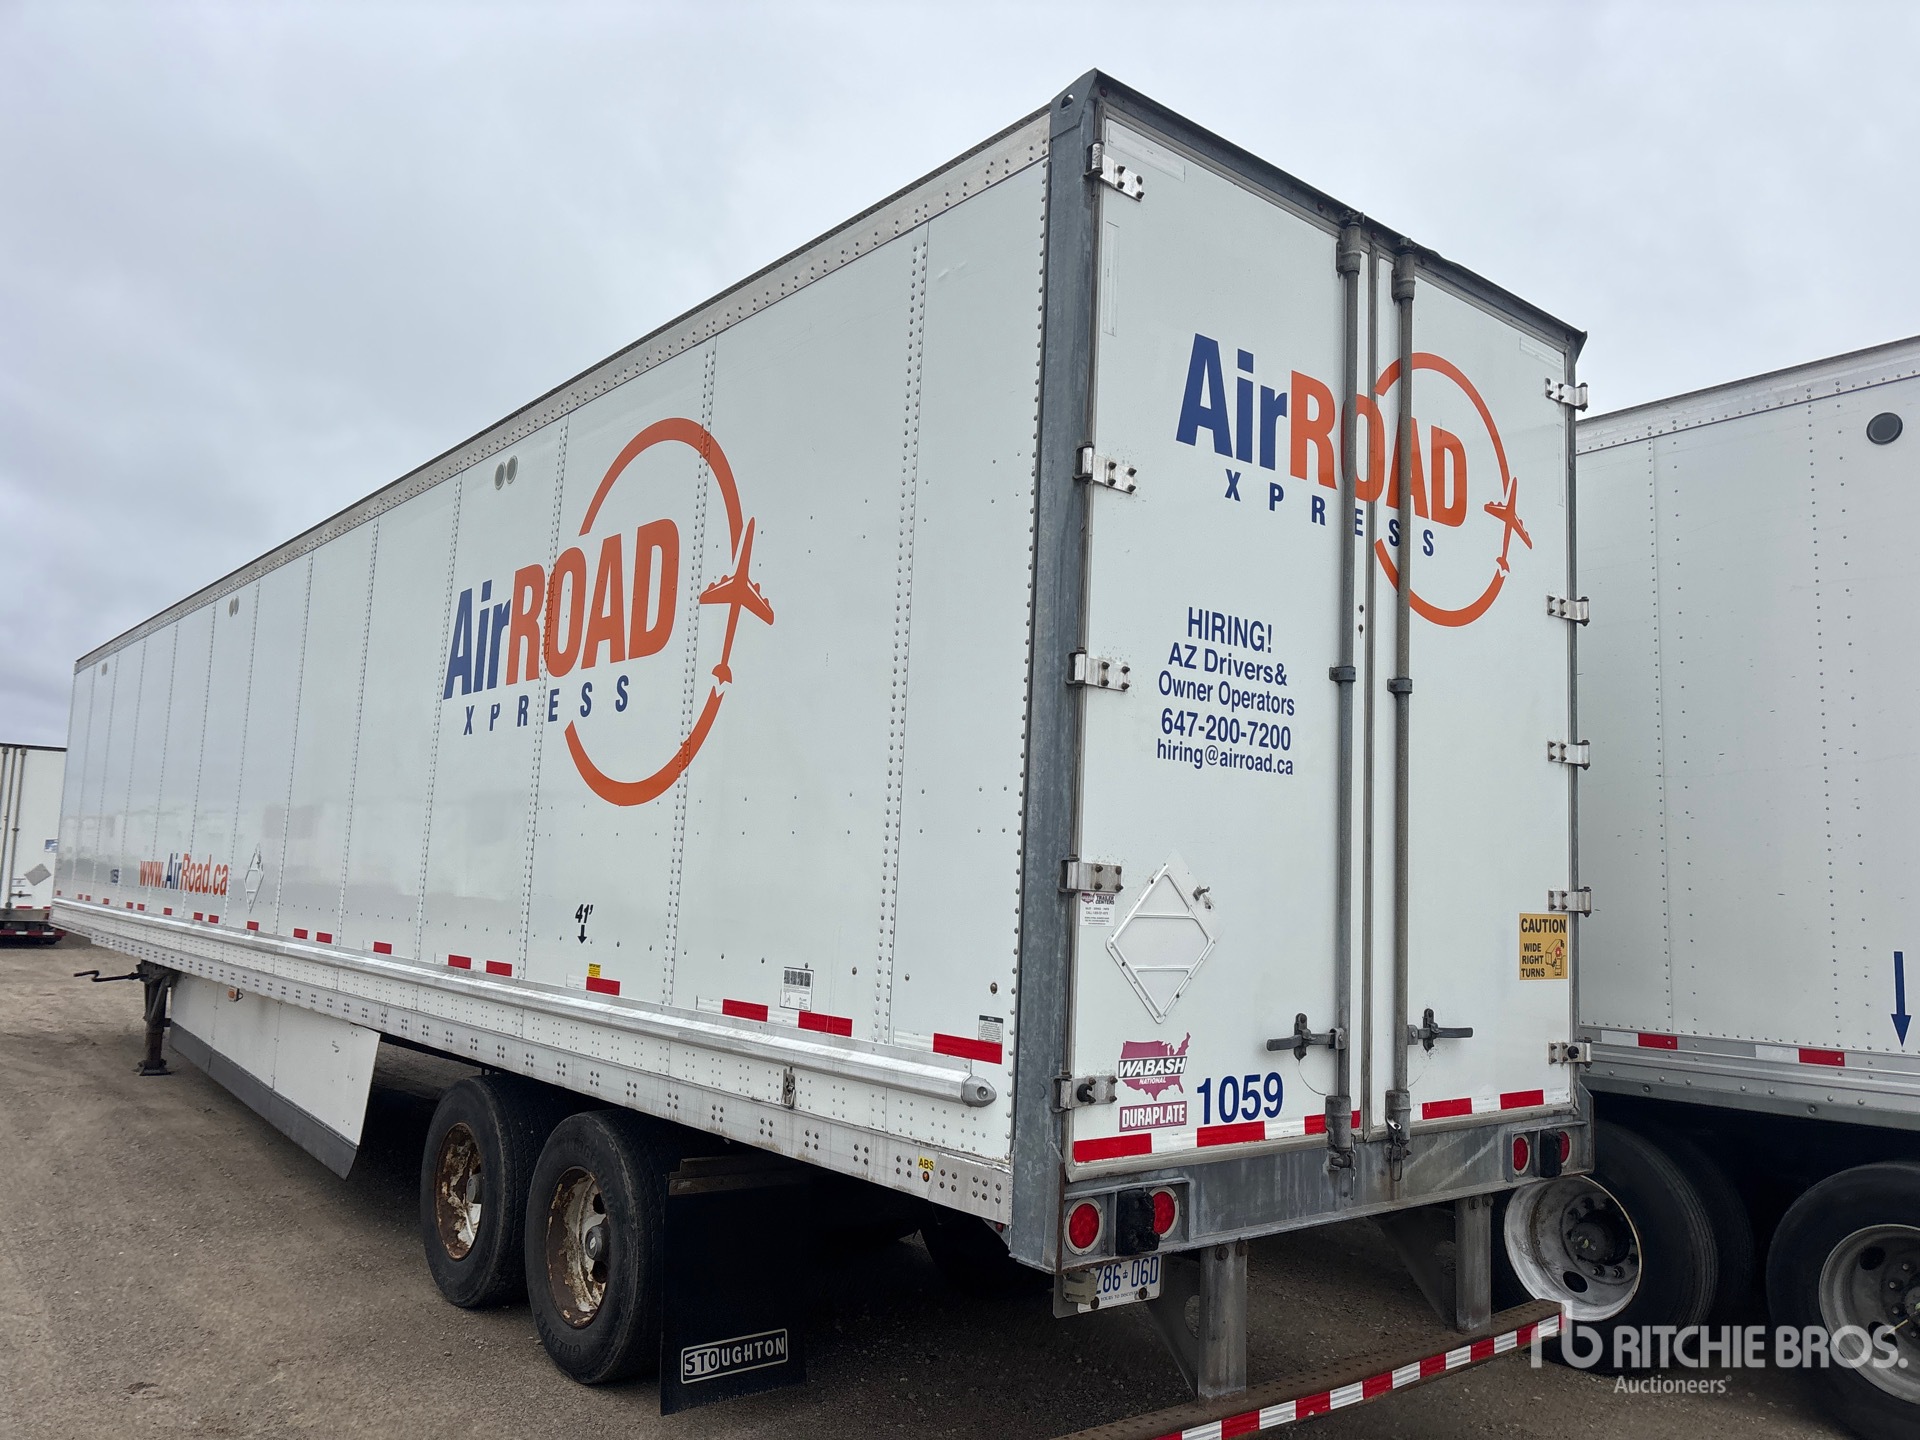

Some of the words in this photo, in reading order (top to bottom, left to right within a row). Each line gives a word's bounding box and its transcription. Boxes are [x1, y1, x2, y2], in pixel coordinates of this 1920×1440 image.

[1175, 332, 1468, 528] AirROAD
[1224, 468, 1435, 557] XPRESS
[442, 518, 680, 700] AirROAD
[1187, 606, 1273, 654] HIRING!
[1168, 642, 1198, 670] AZ
[1204, 648, 1288, 687] Drivers&
[463, 674, 629, 736] XPRESS
[1158, 670, 1214, 702] Owner
[1218, 681, 1295, 717] Operators
[1161, 708, 1292, 751] 647-200-7200
[1157, 738, 1294, 776] hiring@airroad.ca
[139, 852, 229, 896] www.AirRoad.ca
[1521, 917, 1566, 934] CAUTION
[1521, 955, 1544, 965] RIGHT
[1523, 942, 1542, 953] WIDE
[1521, 967, 1546, 978] TURNS
[1118, 1057, 1187, 1078] WABASH
[1139, 1077, 1167, 1085] NATIONAL
[1121, 1103, 1186, 1129] DURAPLATE
[1196, 1071, 1284, 1125] 1059
[918, 1157, 934, 1171] ABS
[685, 1337, 785, 1374] STOUGHTON
